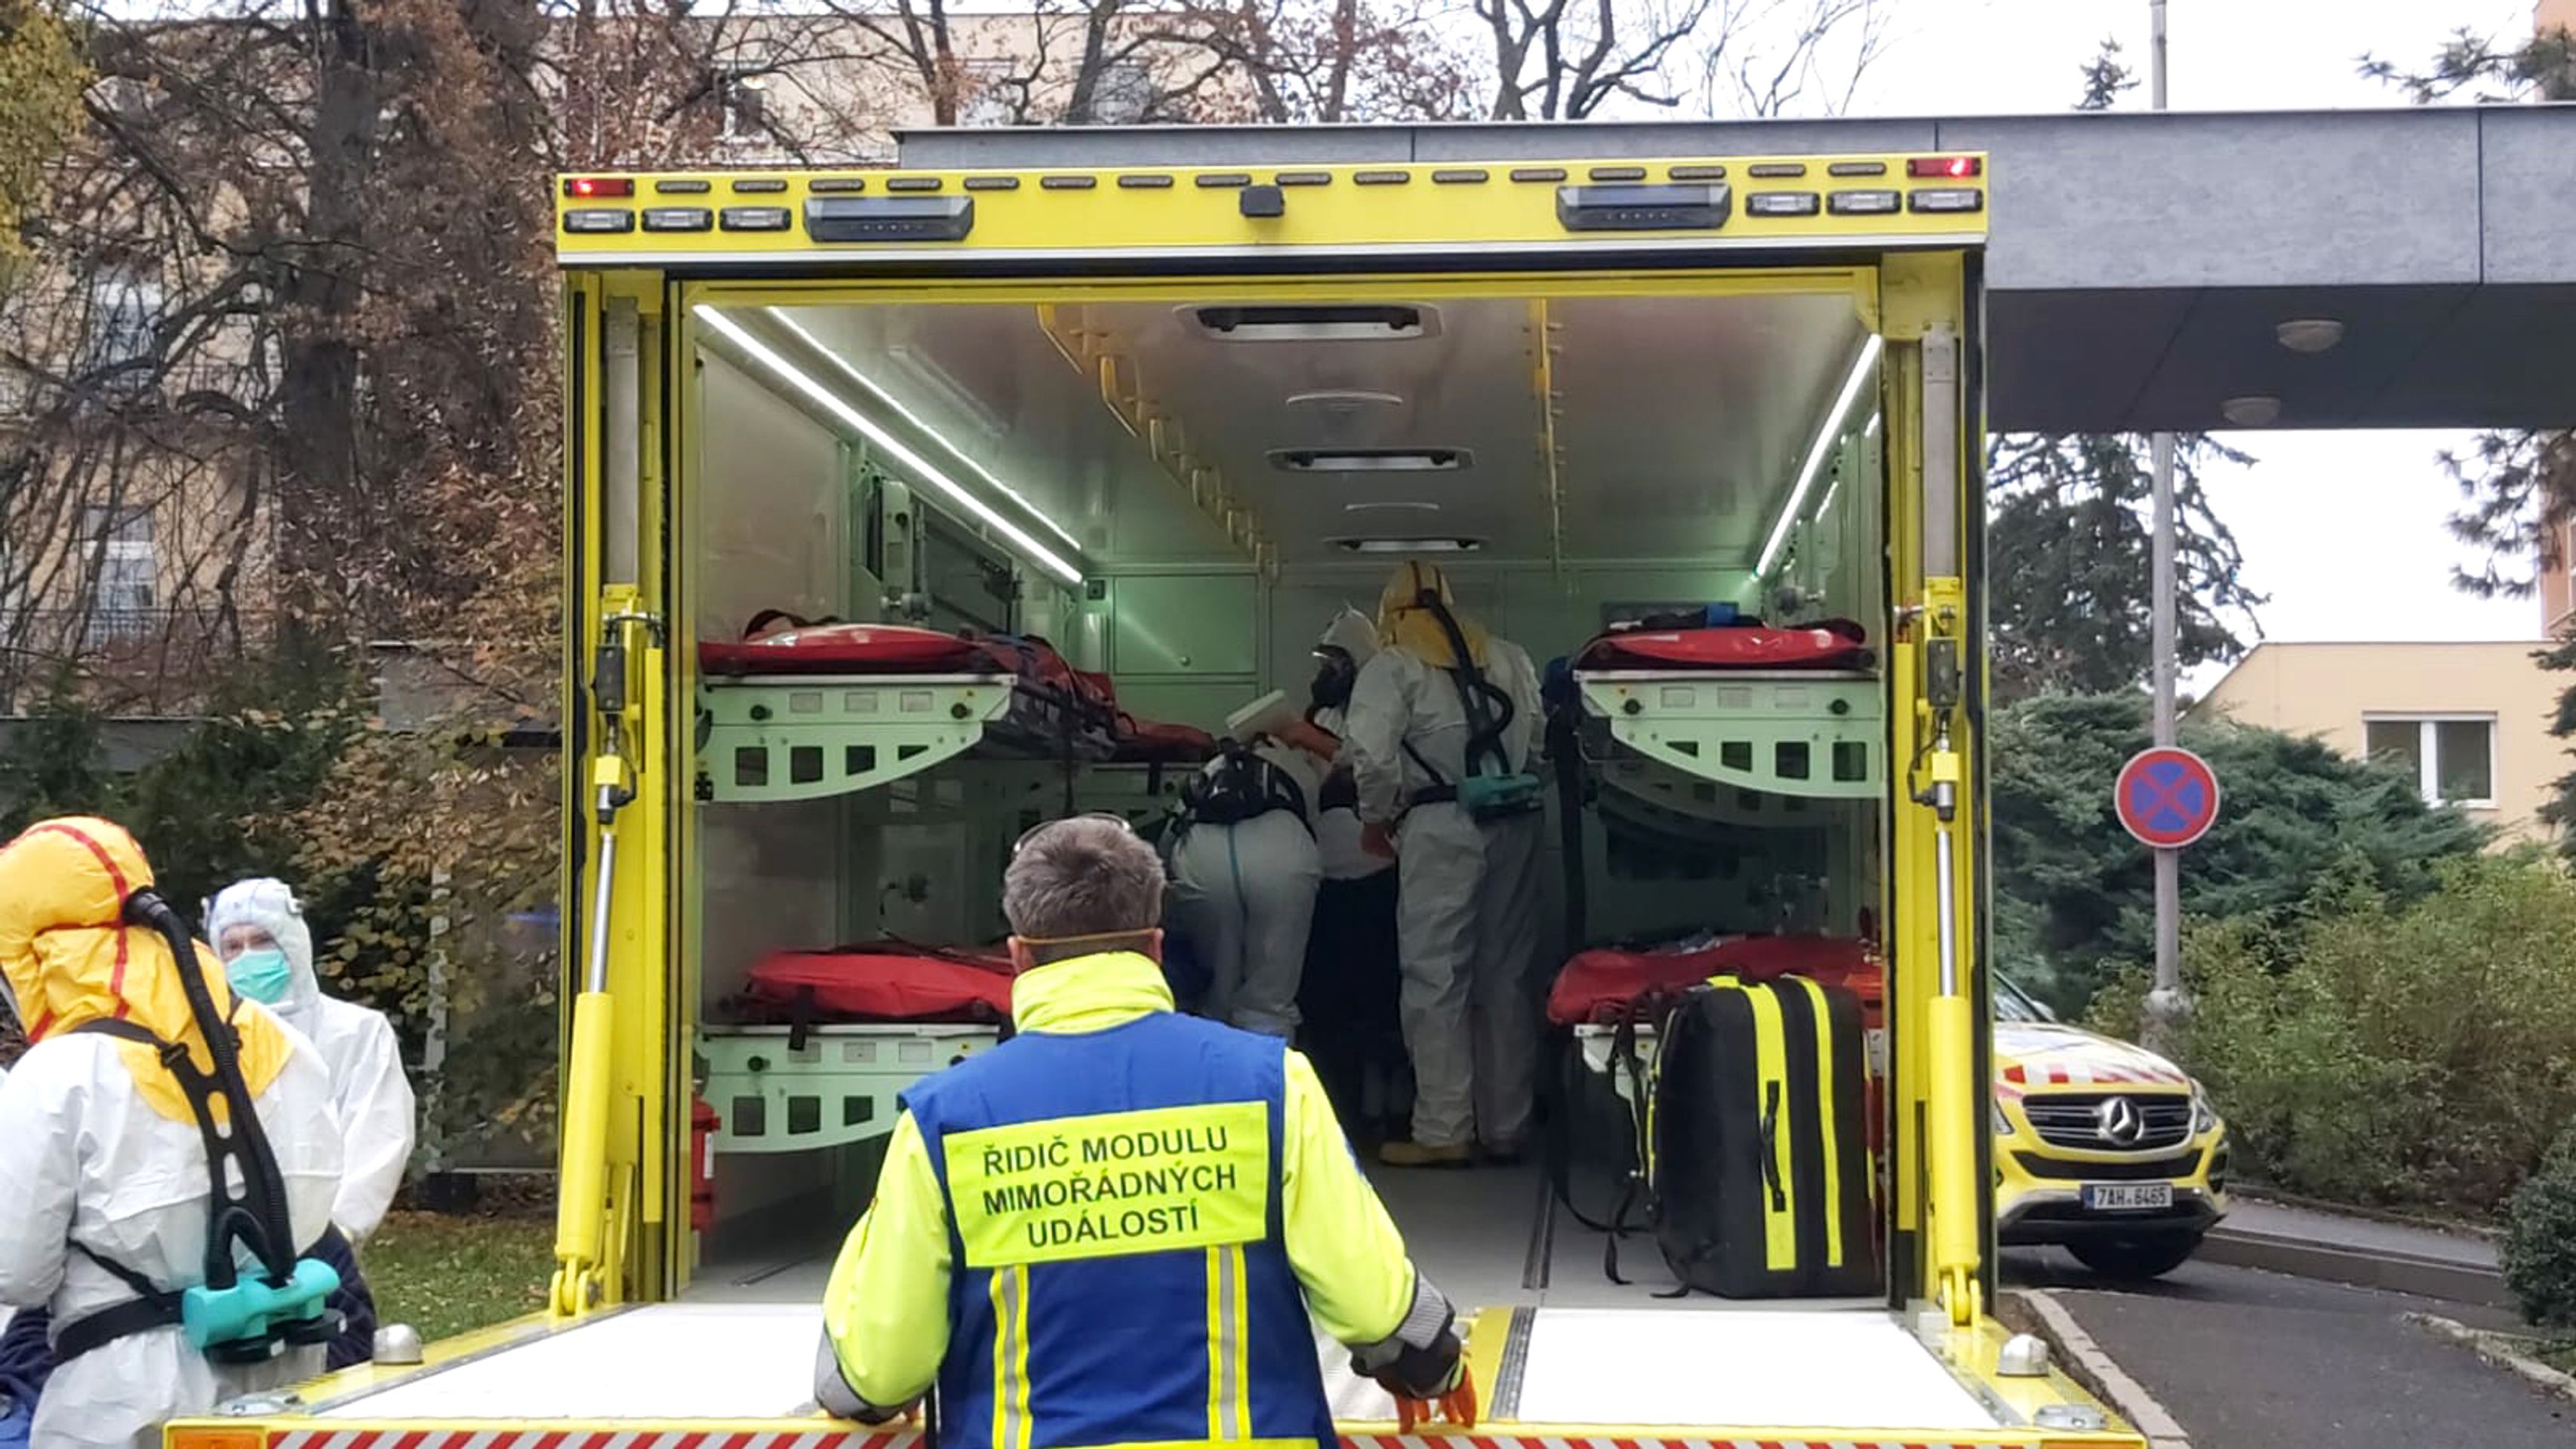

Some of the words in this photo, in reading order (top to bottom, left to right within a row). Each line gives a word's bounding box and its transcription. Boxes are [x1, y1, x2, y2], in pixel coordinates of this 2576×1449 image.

[983, 1135, 1069, 1177] ŘIDIČ
[1082, 1126, 1228, 1164] MODULU
[983, 1161, 1236, 1216] MIMOŘÁDNÝCH
[1027, 1198, 1199, 1248] UDÁLOSTÍ
